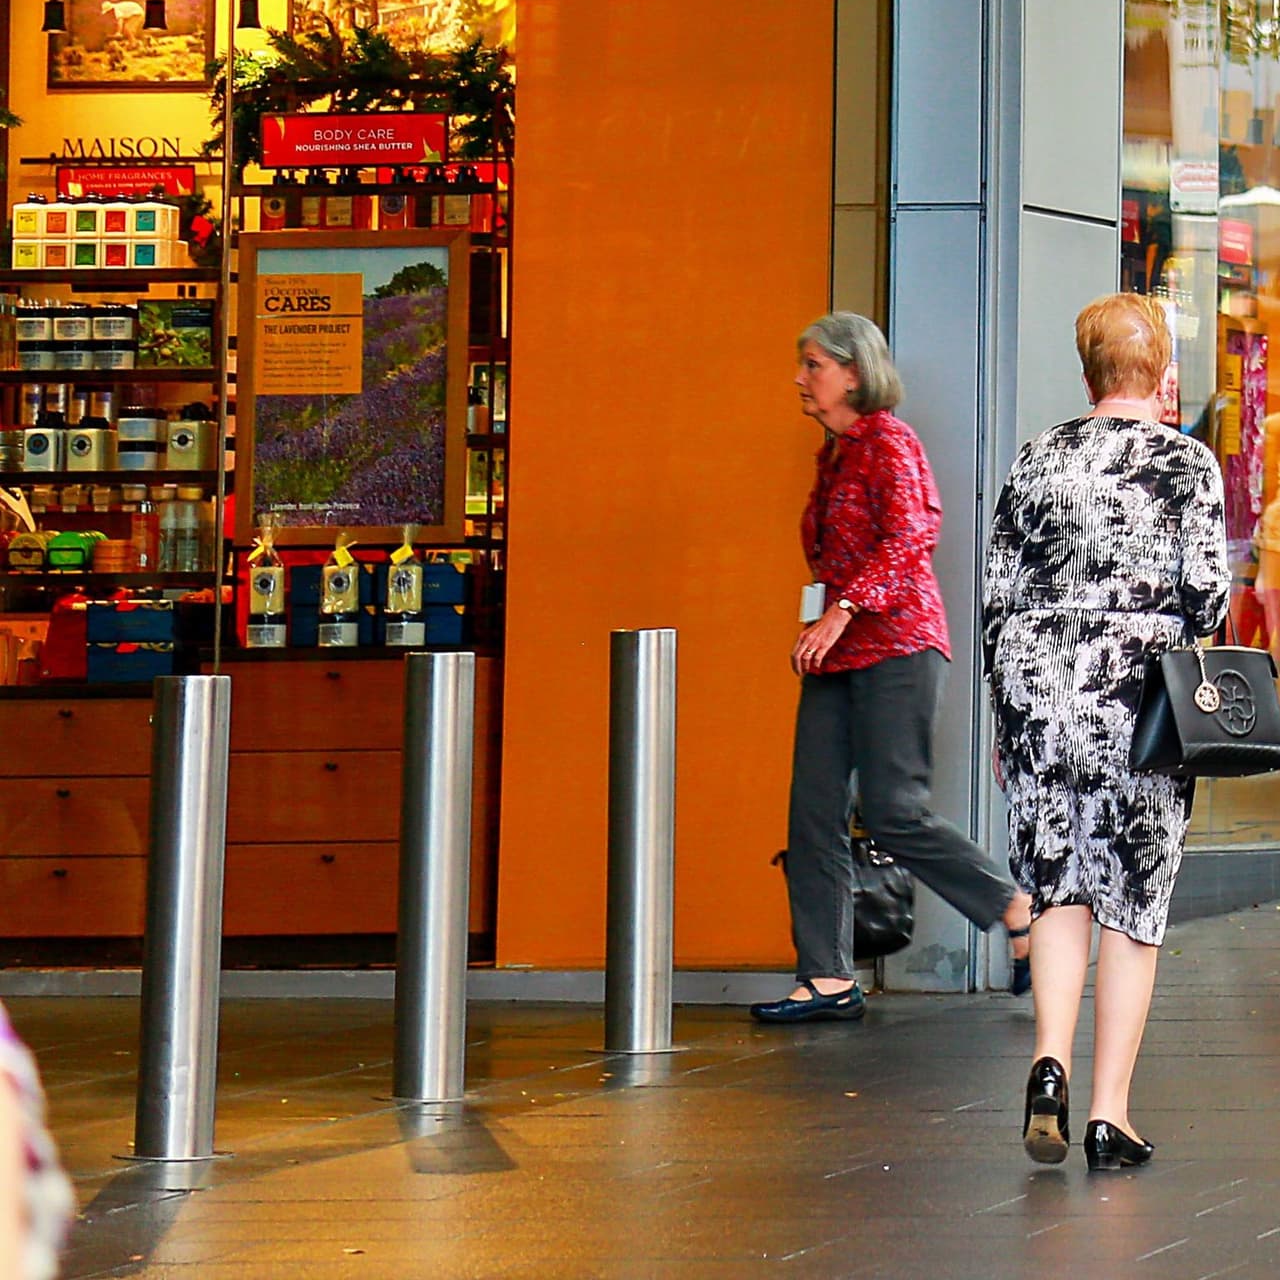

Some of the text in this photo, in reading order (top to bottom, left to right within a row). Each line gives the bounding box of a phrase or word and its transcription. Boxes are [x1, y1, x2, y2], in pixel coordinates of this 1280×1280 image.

[314, 128, 395, 141] BODY CARE
[63, 137, 180, 158] MAISON
[295, 142, 413, 152] NOURISHING SHEA BUTTER
[264, 296, 331, 312] CARES
[264, 323, 351, 335] THE LAVENDER PROJECT
